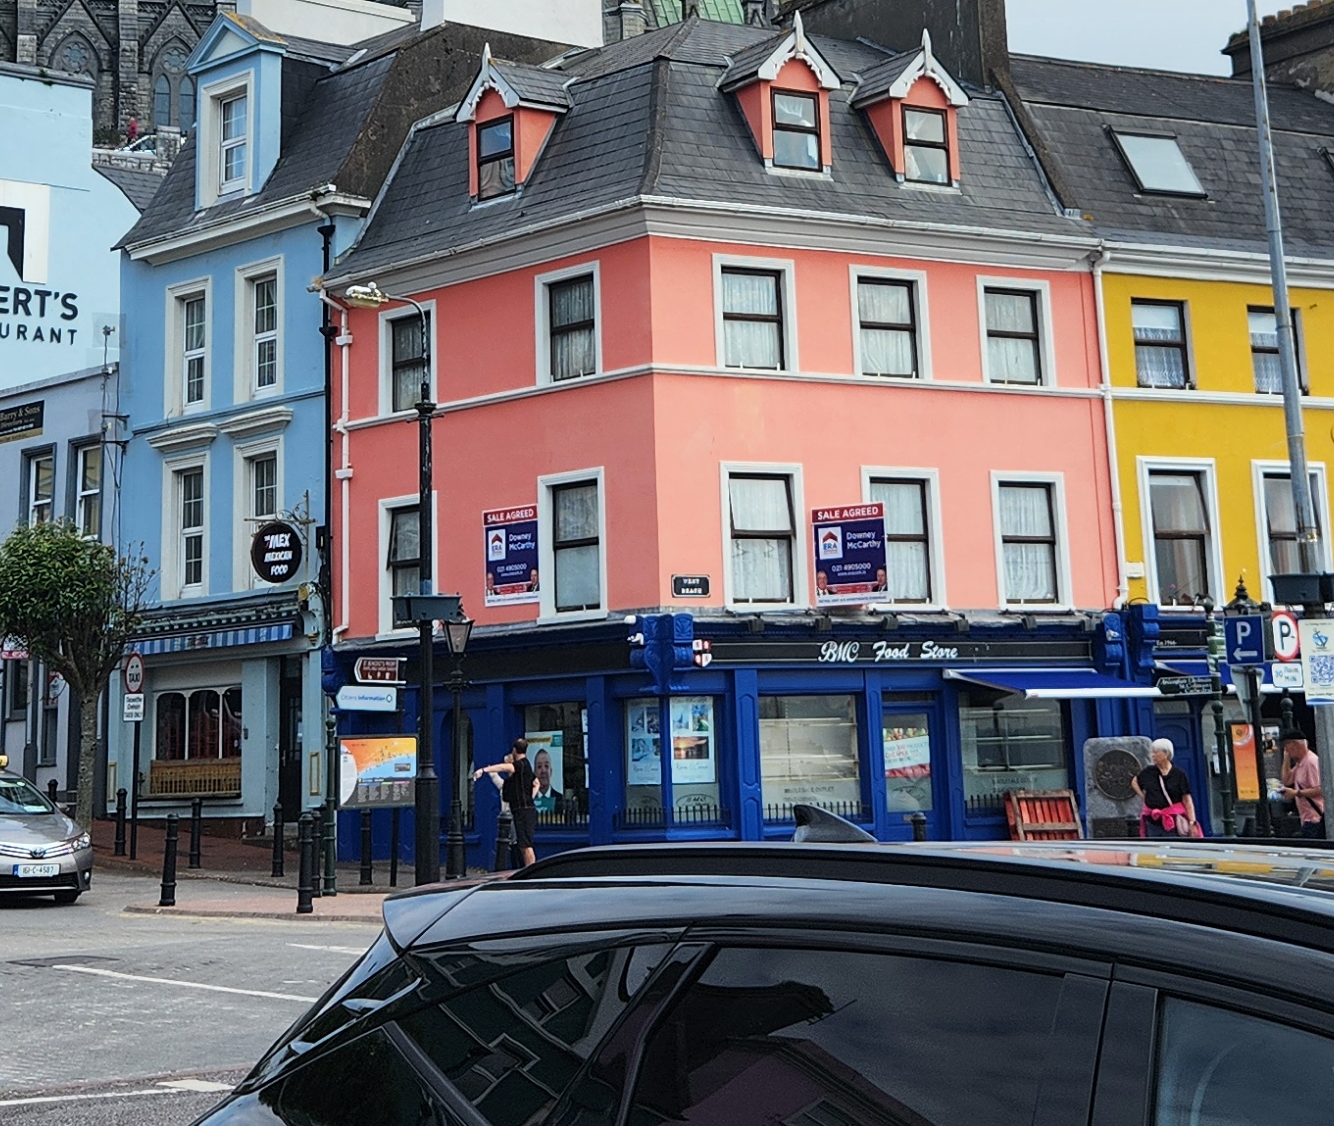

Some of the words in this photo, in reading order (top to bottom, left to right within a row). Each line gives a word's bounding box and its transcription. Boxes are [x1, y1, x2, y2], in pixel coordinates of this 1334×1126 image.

[0, 411, 18, 424] Barry
[18, 410, 24, 418] &
[25, 405, 41, 416] Sons
[487, 512, 505, 523] SALE
[506, 508, 534, 520] AGREED
[817, 510, 840, 521] SALE
[842, 506, 879, 518] AGREED
[269, 533, 291, 549] MEX
[508, 533, 532, 542] Downey
[846, 531, 876, 540] Downey
[508, 541, 535, 551] McCarthy
[847, 539, 881, 549] McCarthy
[270, 564, 289, 575] FOOD
[1236, 621, 1251, 645] P
[1278, 620, 1291, 650] P
[818, 640, 860, 662] BMC
[872, 641, 910, 662] Food
[920, 640, 959, 659] Store
